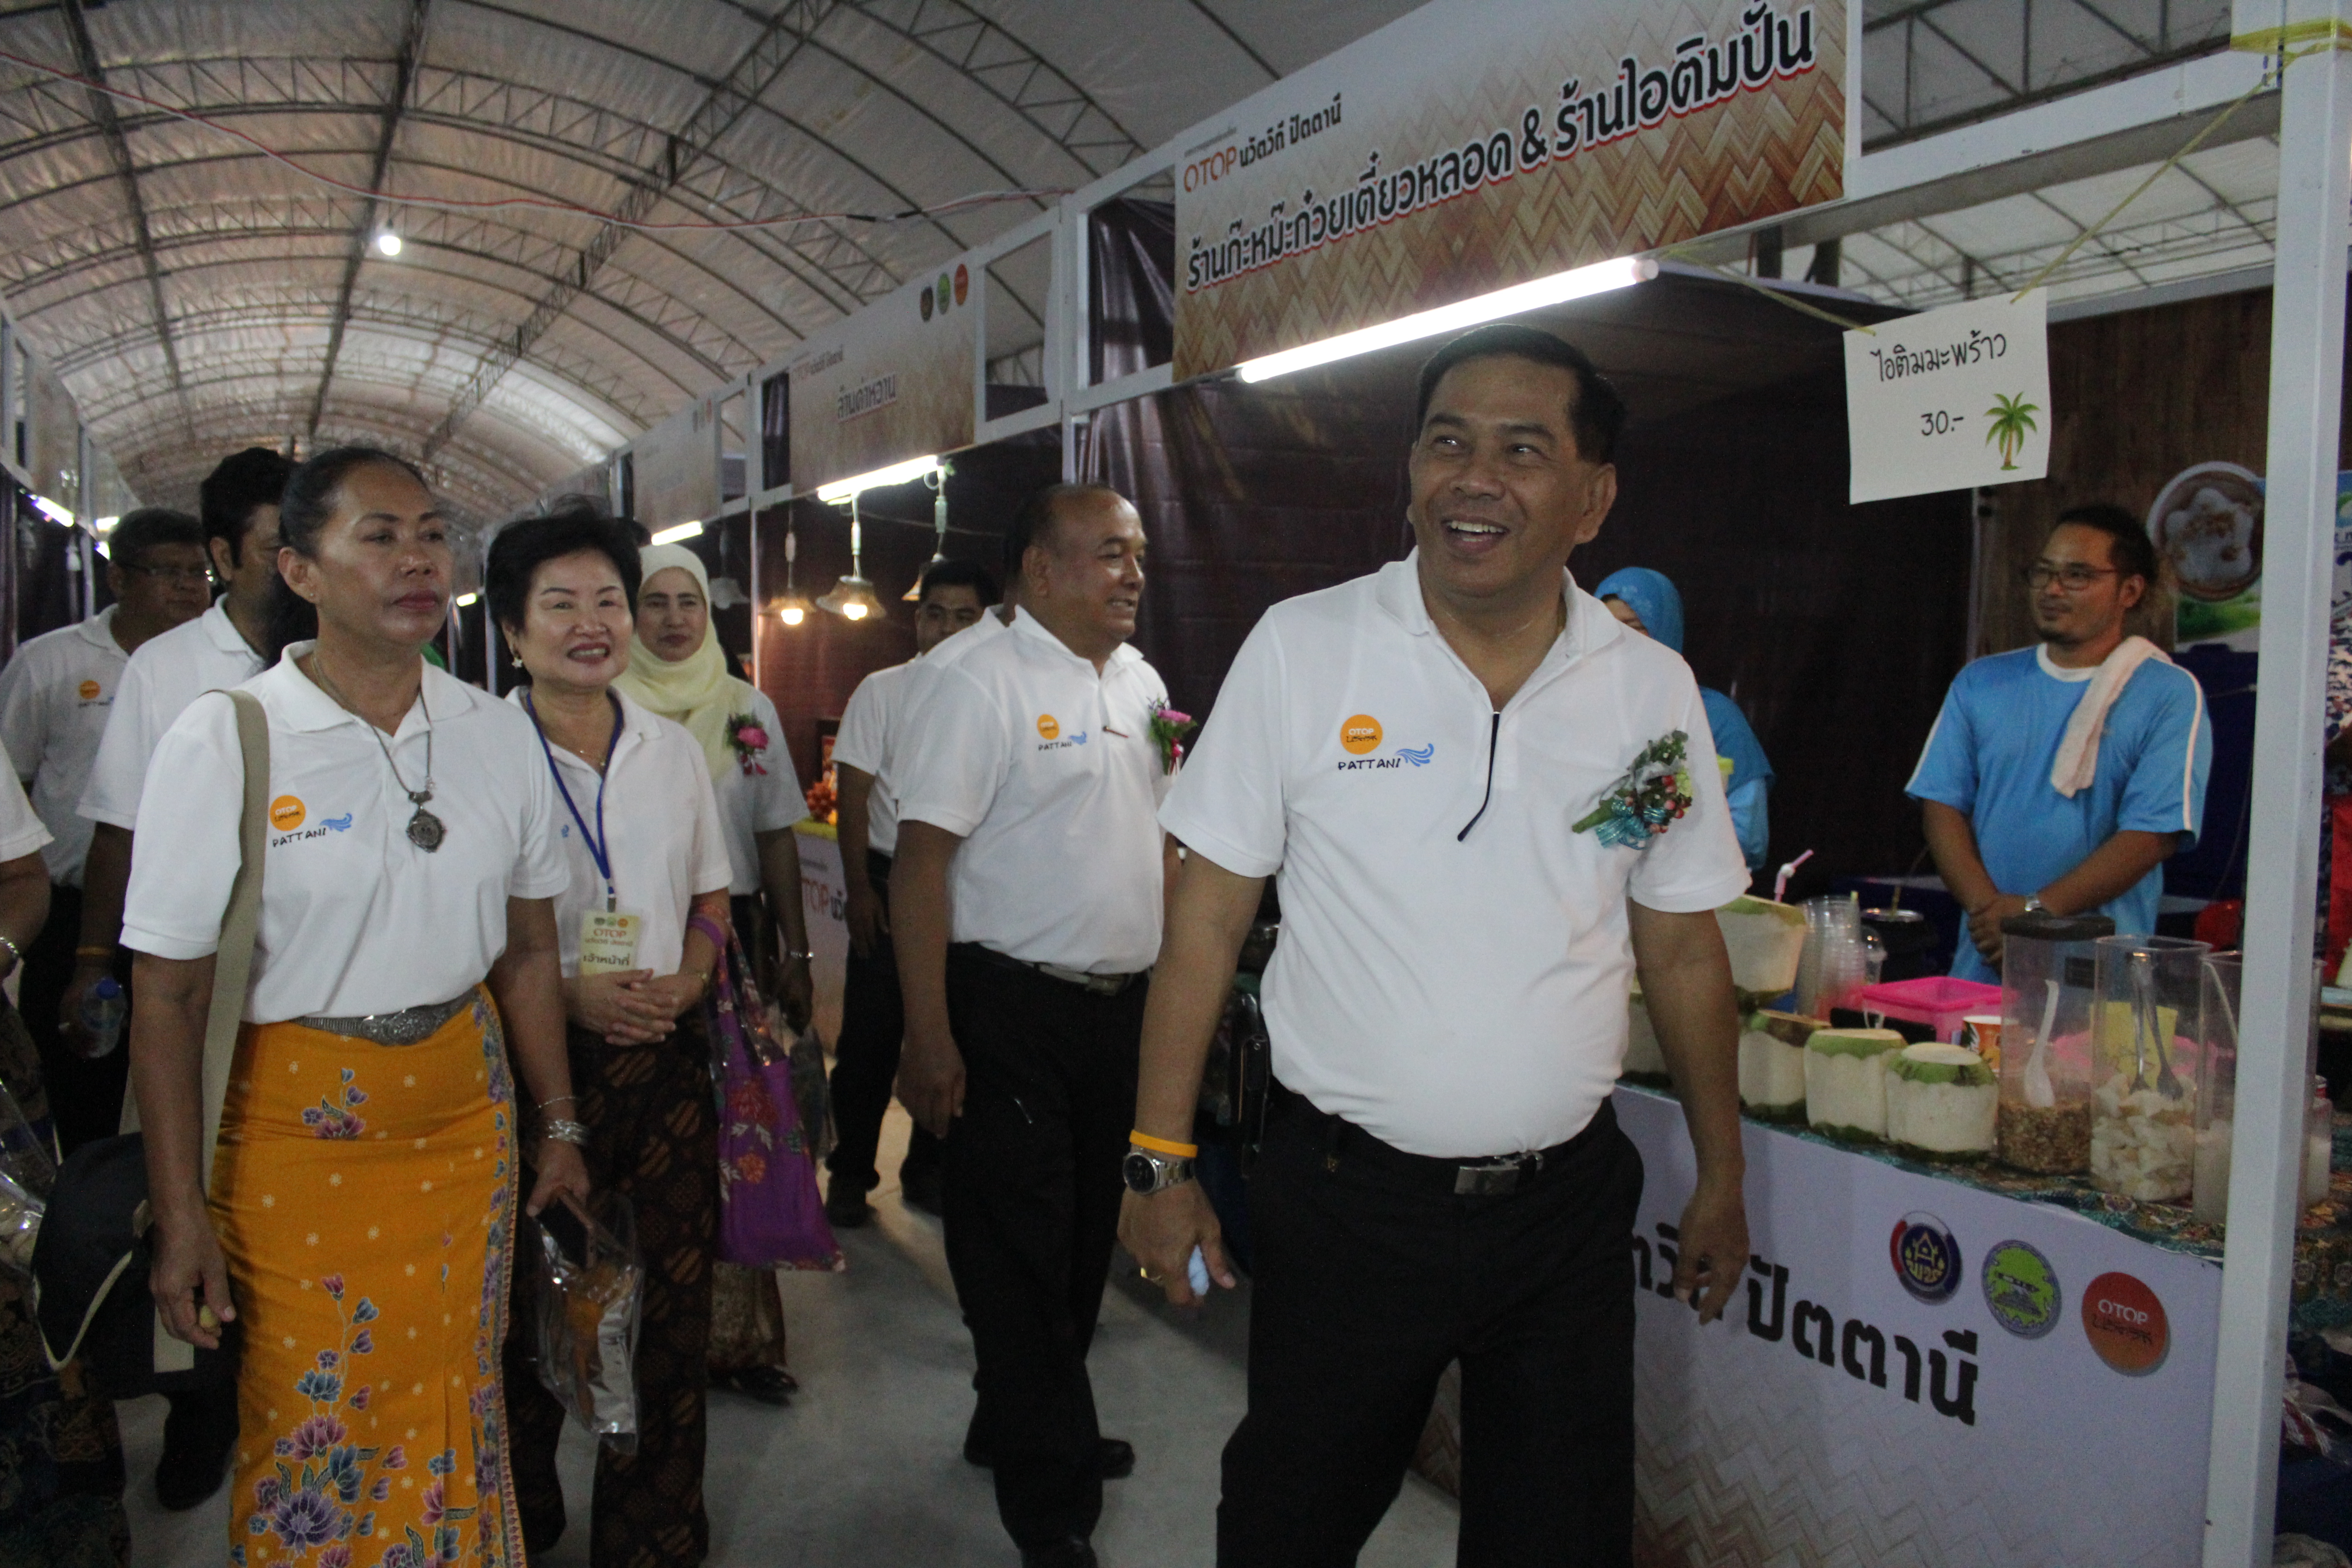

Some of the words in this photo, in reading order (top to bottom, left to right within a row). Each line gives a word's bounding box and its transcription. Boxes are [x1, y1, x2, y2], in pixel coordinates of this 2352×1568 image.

[1520, 108, 1548, 165] &
[1556, 0, 1813, 152] ร้านไอติมปัน
[1184, 146, 1237, 193] OTOP
[1240, 120, 1285, 167] นวัตวิถี
[1289, 92, 1342, 145] ปัตตานี
[1870, 330, 2007, 382] ไอติมมะพร้าว
[1921, 410, 1965, 436] 30.-
[1338, 758, 1401, 770] PATTANI
[275, 805, 298, 816] OTOP
[272, 827, 327, 848] PATTANI
[2098, 1299, 2148, 1325] OTOP
[1747, 1254, 1979, 1426] ปัตตานี
